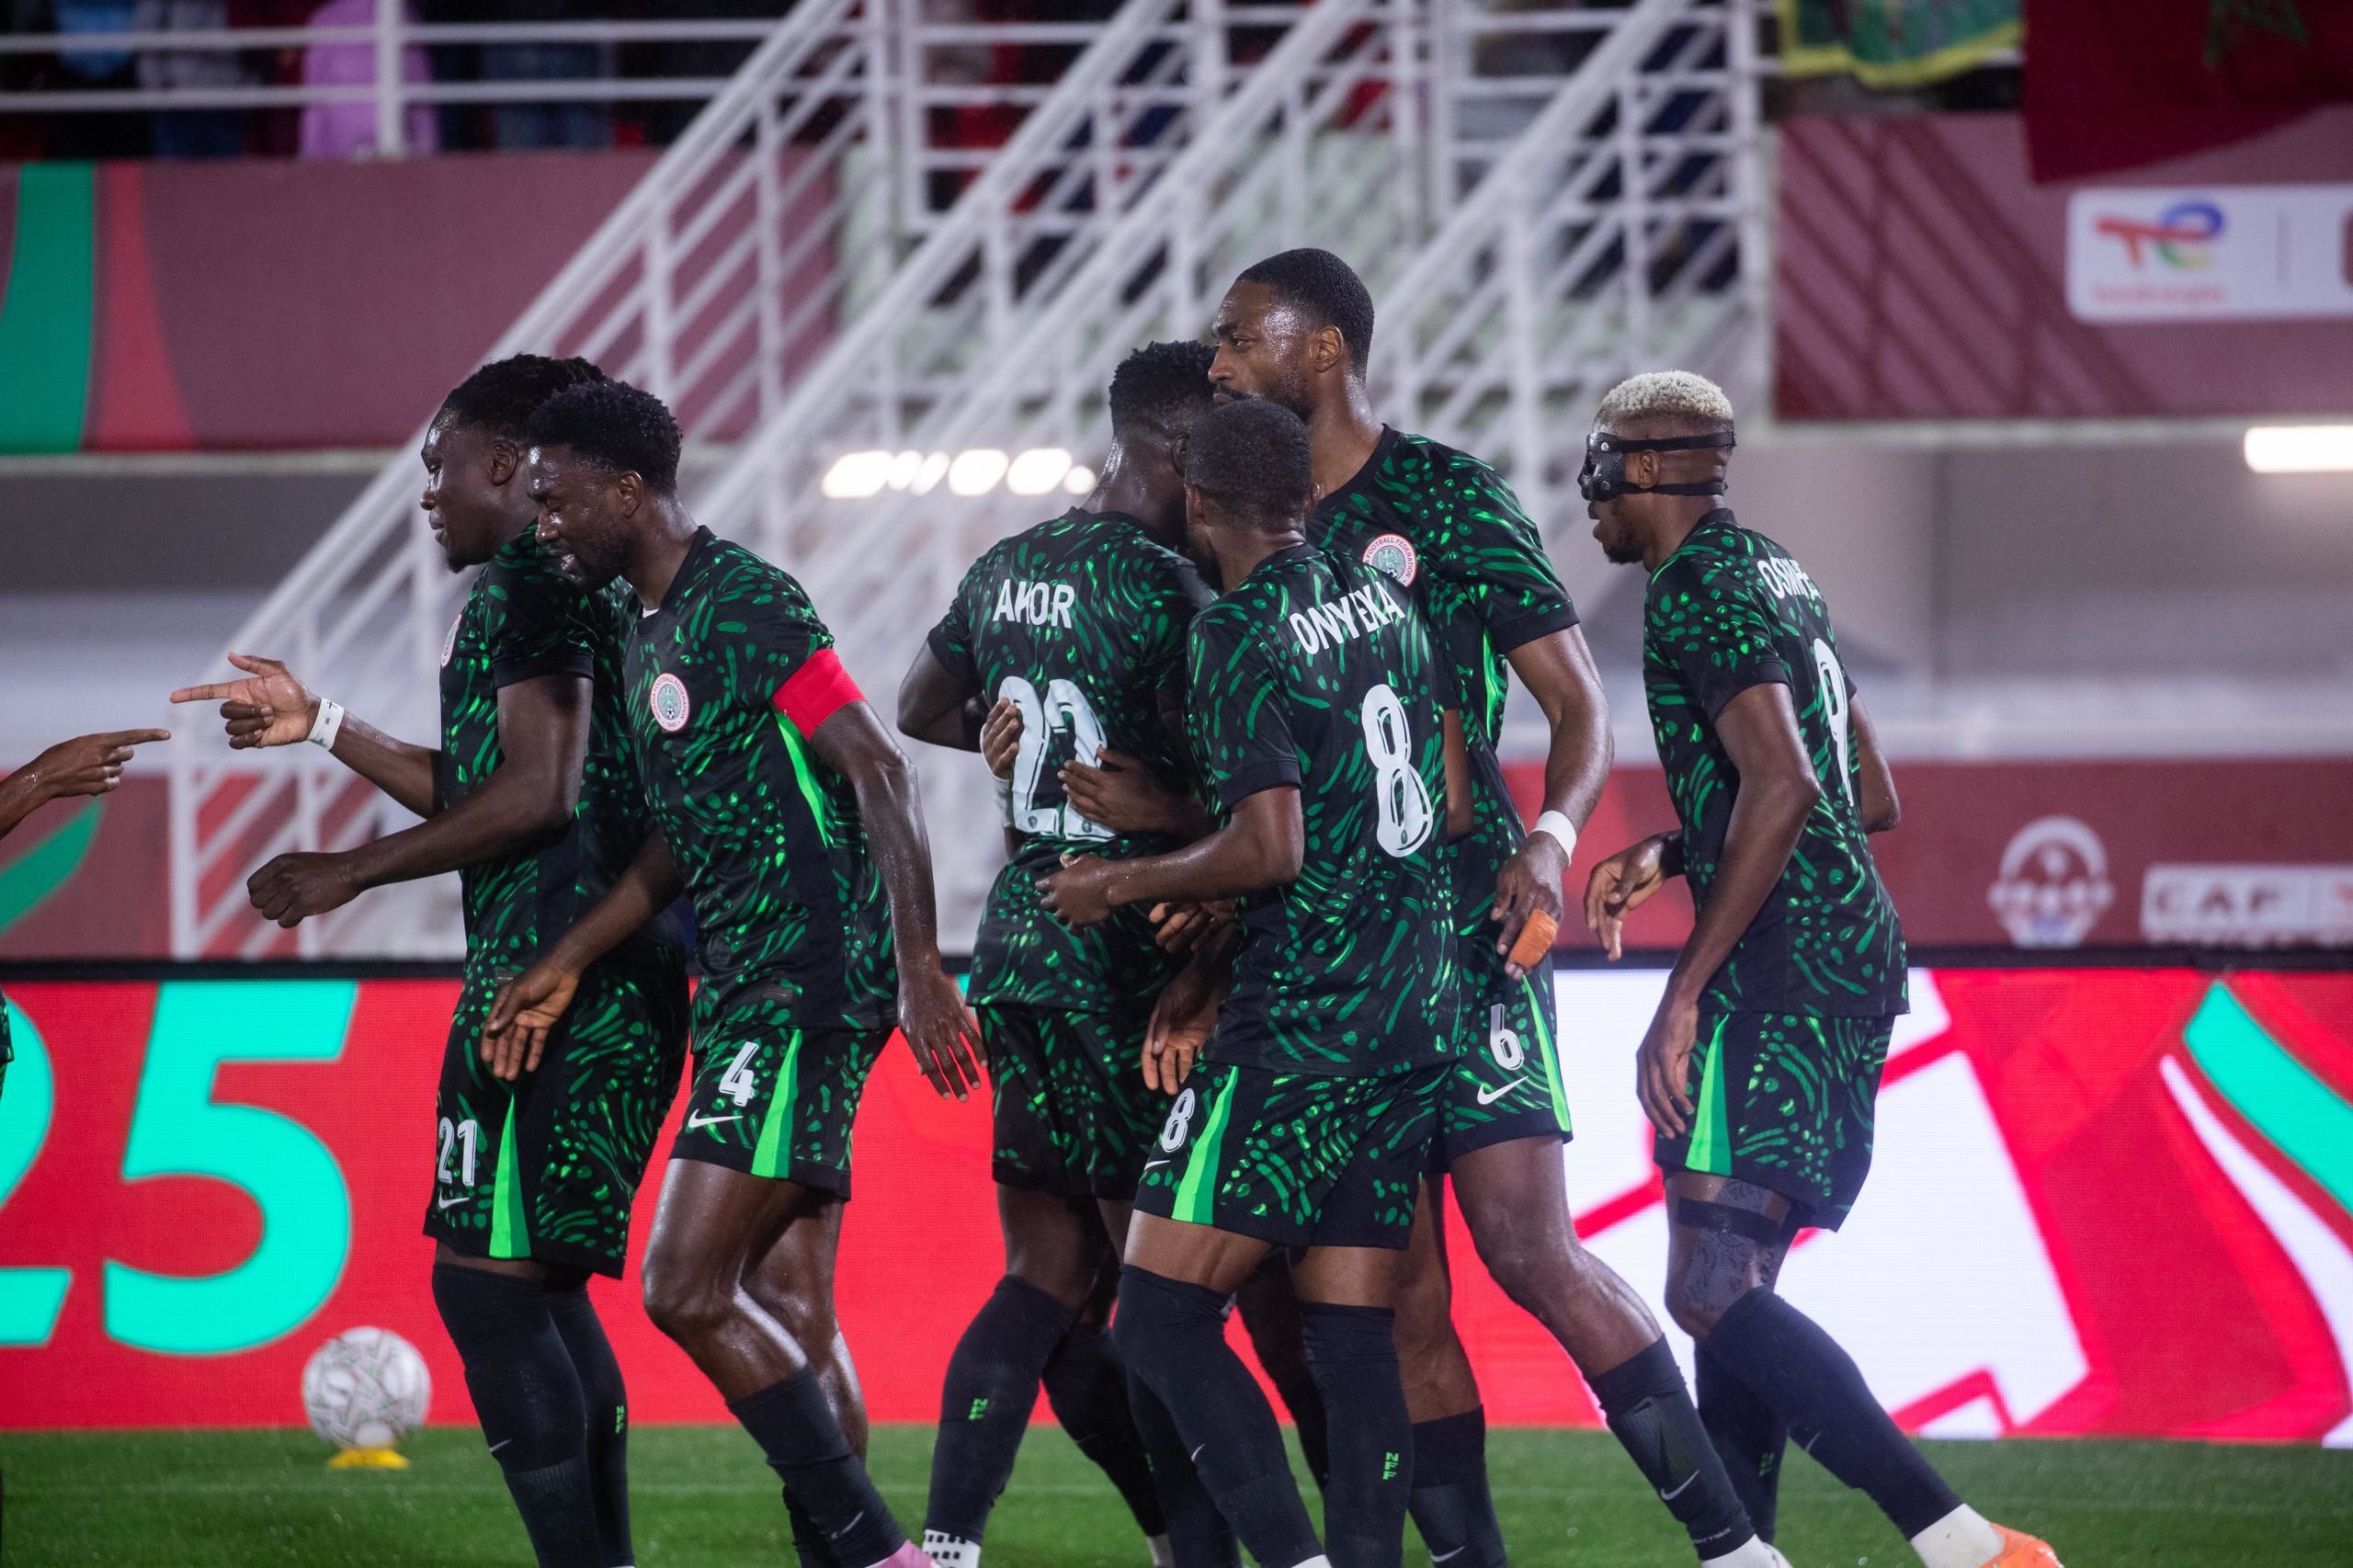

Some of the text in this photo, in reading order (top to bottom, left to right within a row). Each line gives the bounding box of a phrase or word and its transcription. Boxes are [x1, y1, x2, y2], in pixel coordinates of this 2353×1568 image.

[1395, 539, 1414, 578] FEDERATION
[1290, 581, 1405, 654] ONYEKA
[1361, 684, 1434, 858] 8
[1489, 1003, 1525, 1071] 6
[718, 1040, 760, 1108] 4
[438, 1117, 478, 1187] 21
[1162, 1087, 1195, 1153] 8
[1381, 1451, 1400, 1480] NFF
